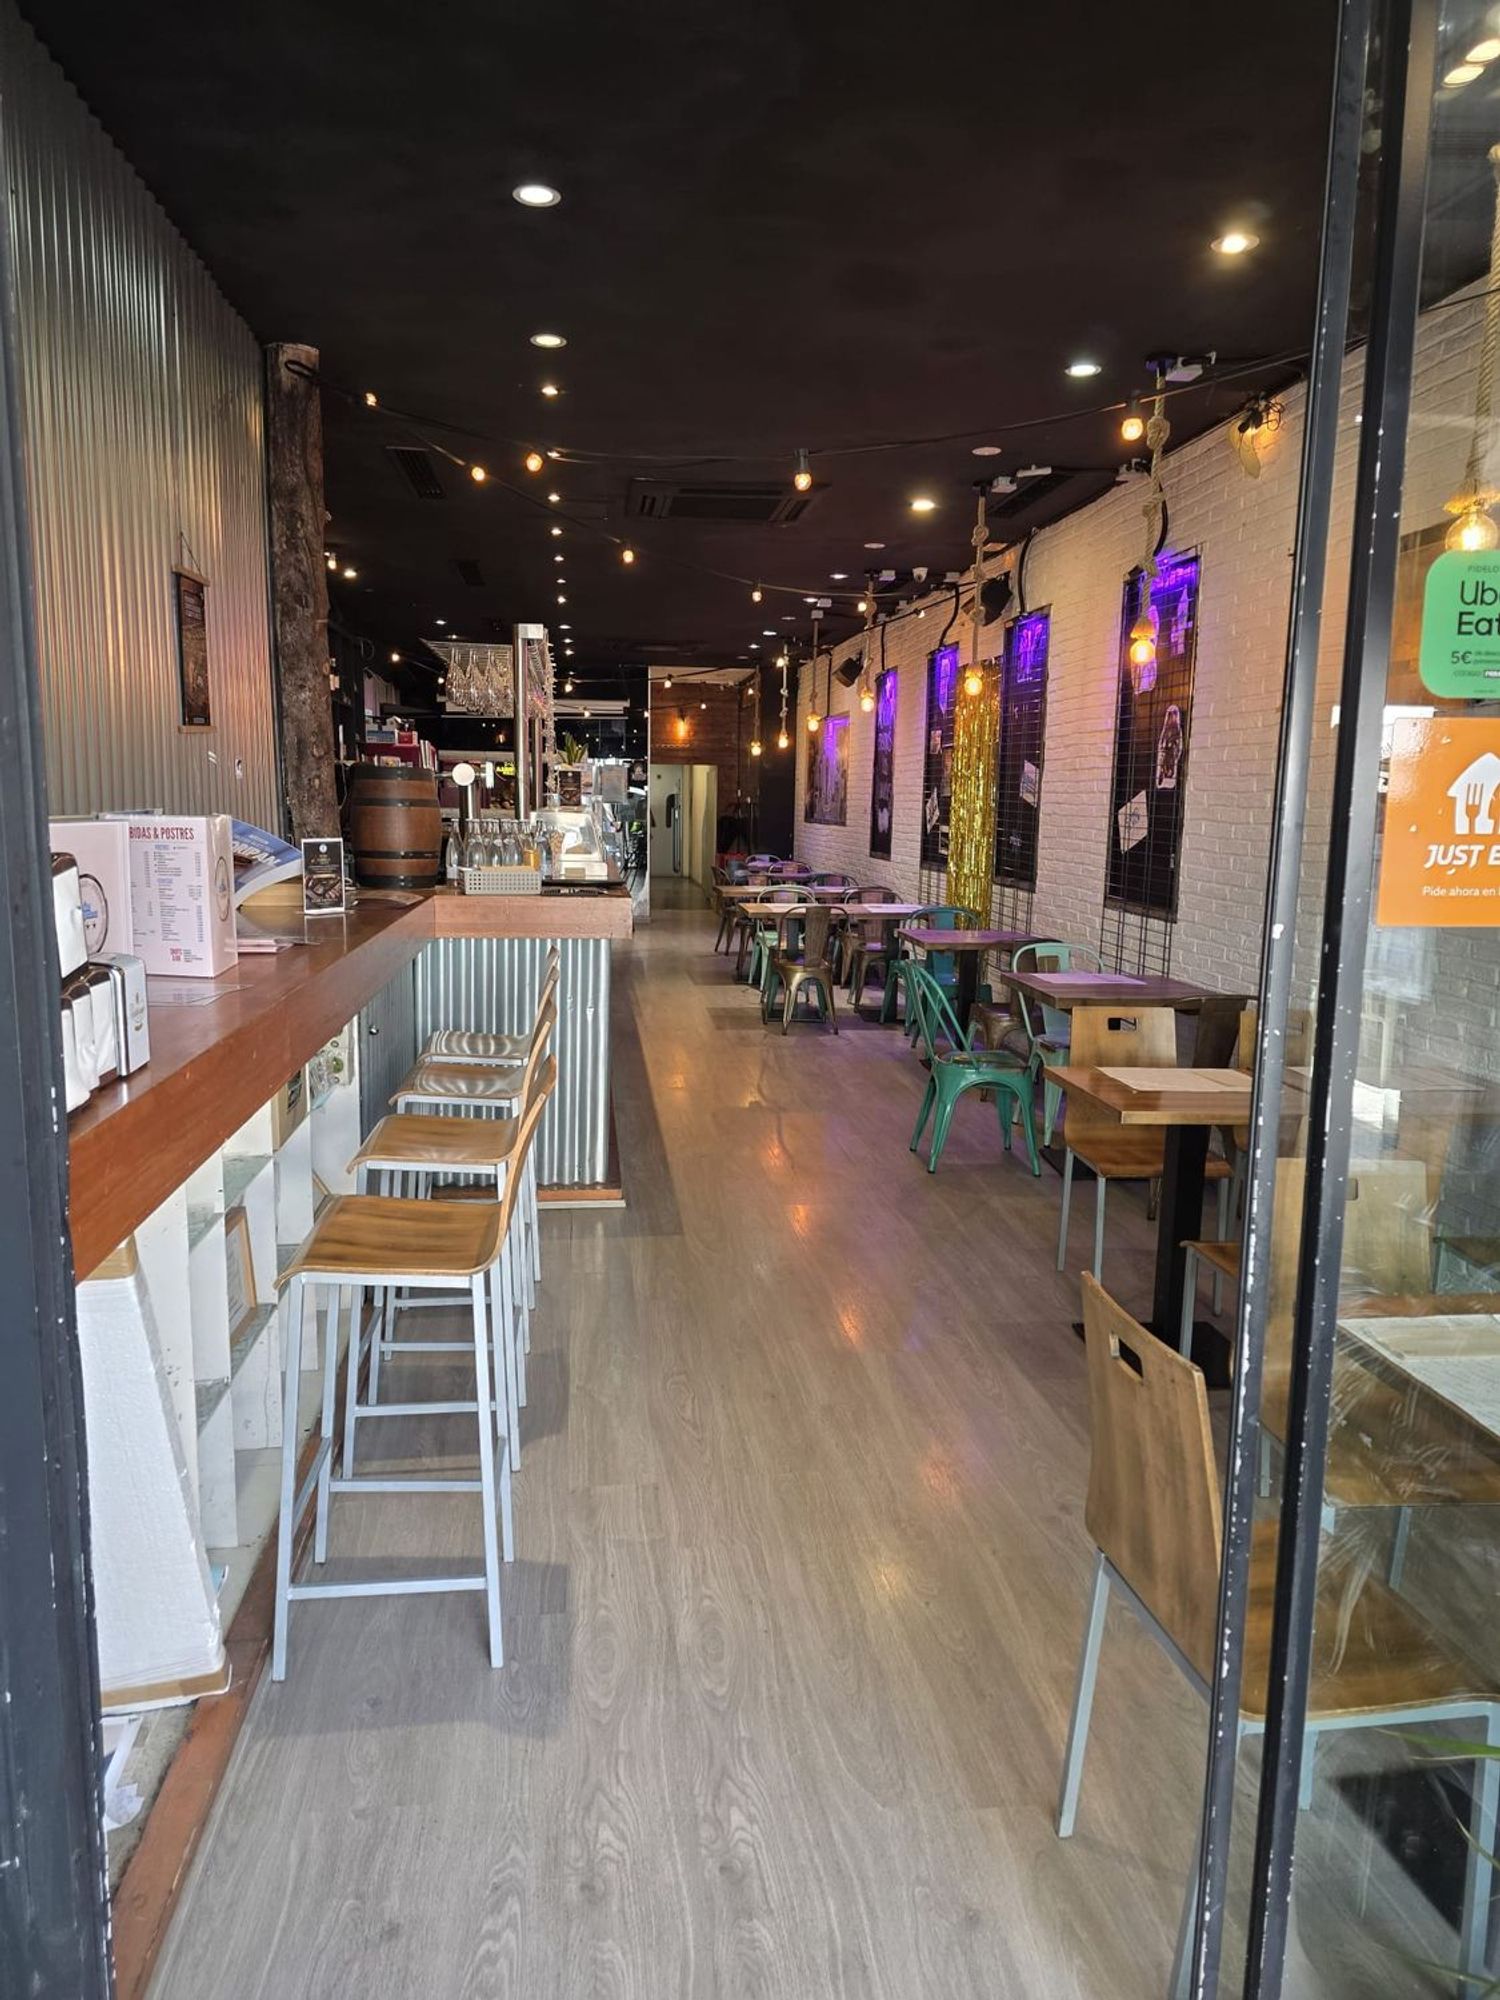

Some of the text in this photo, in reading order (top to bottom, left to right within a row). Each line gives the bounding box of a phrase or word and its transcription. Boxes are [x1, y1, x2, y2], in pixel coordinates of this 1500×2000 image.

[1460, 580, 1500, 606] Ub
[1451, 650, 1472, 665] 5€
[160, 827, 195, 840] POSTRES
[1423, 844, 1485, 869] JUST
[1423, 886, 1496, 896] Pide ahora en
